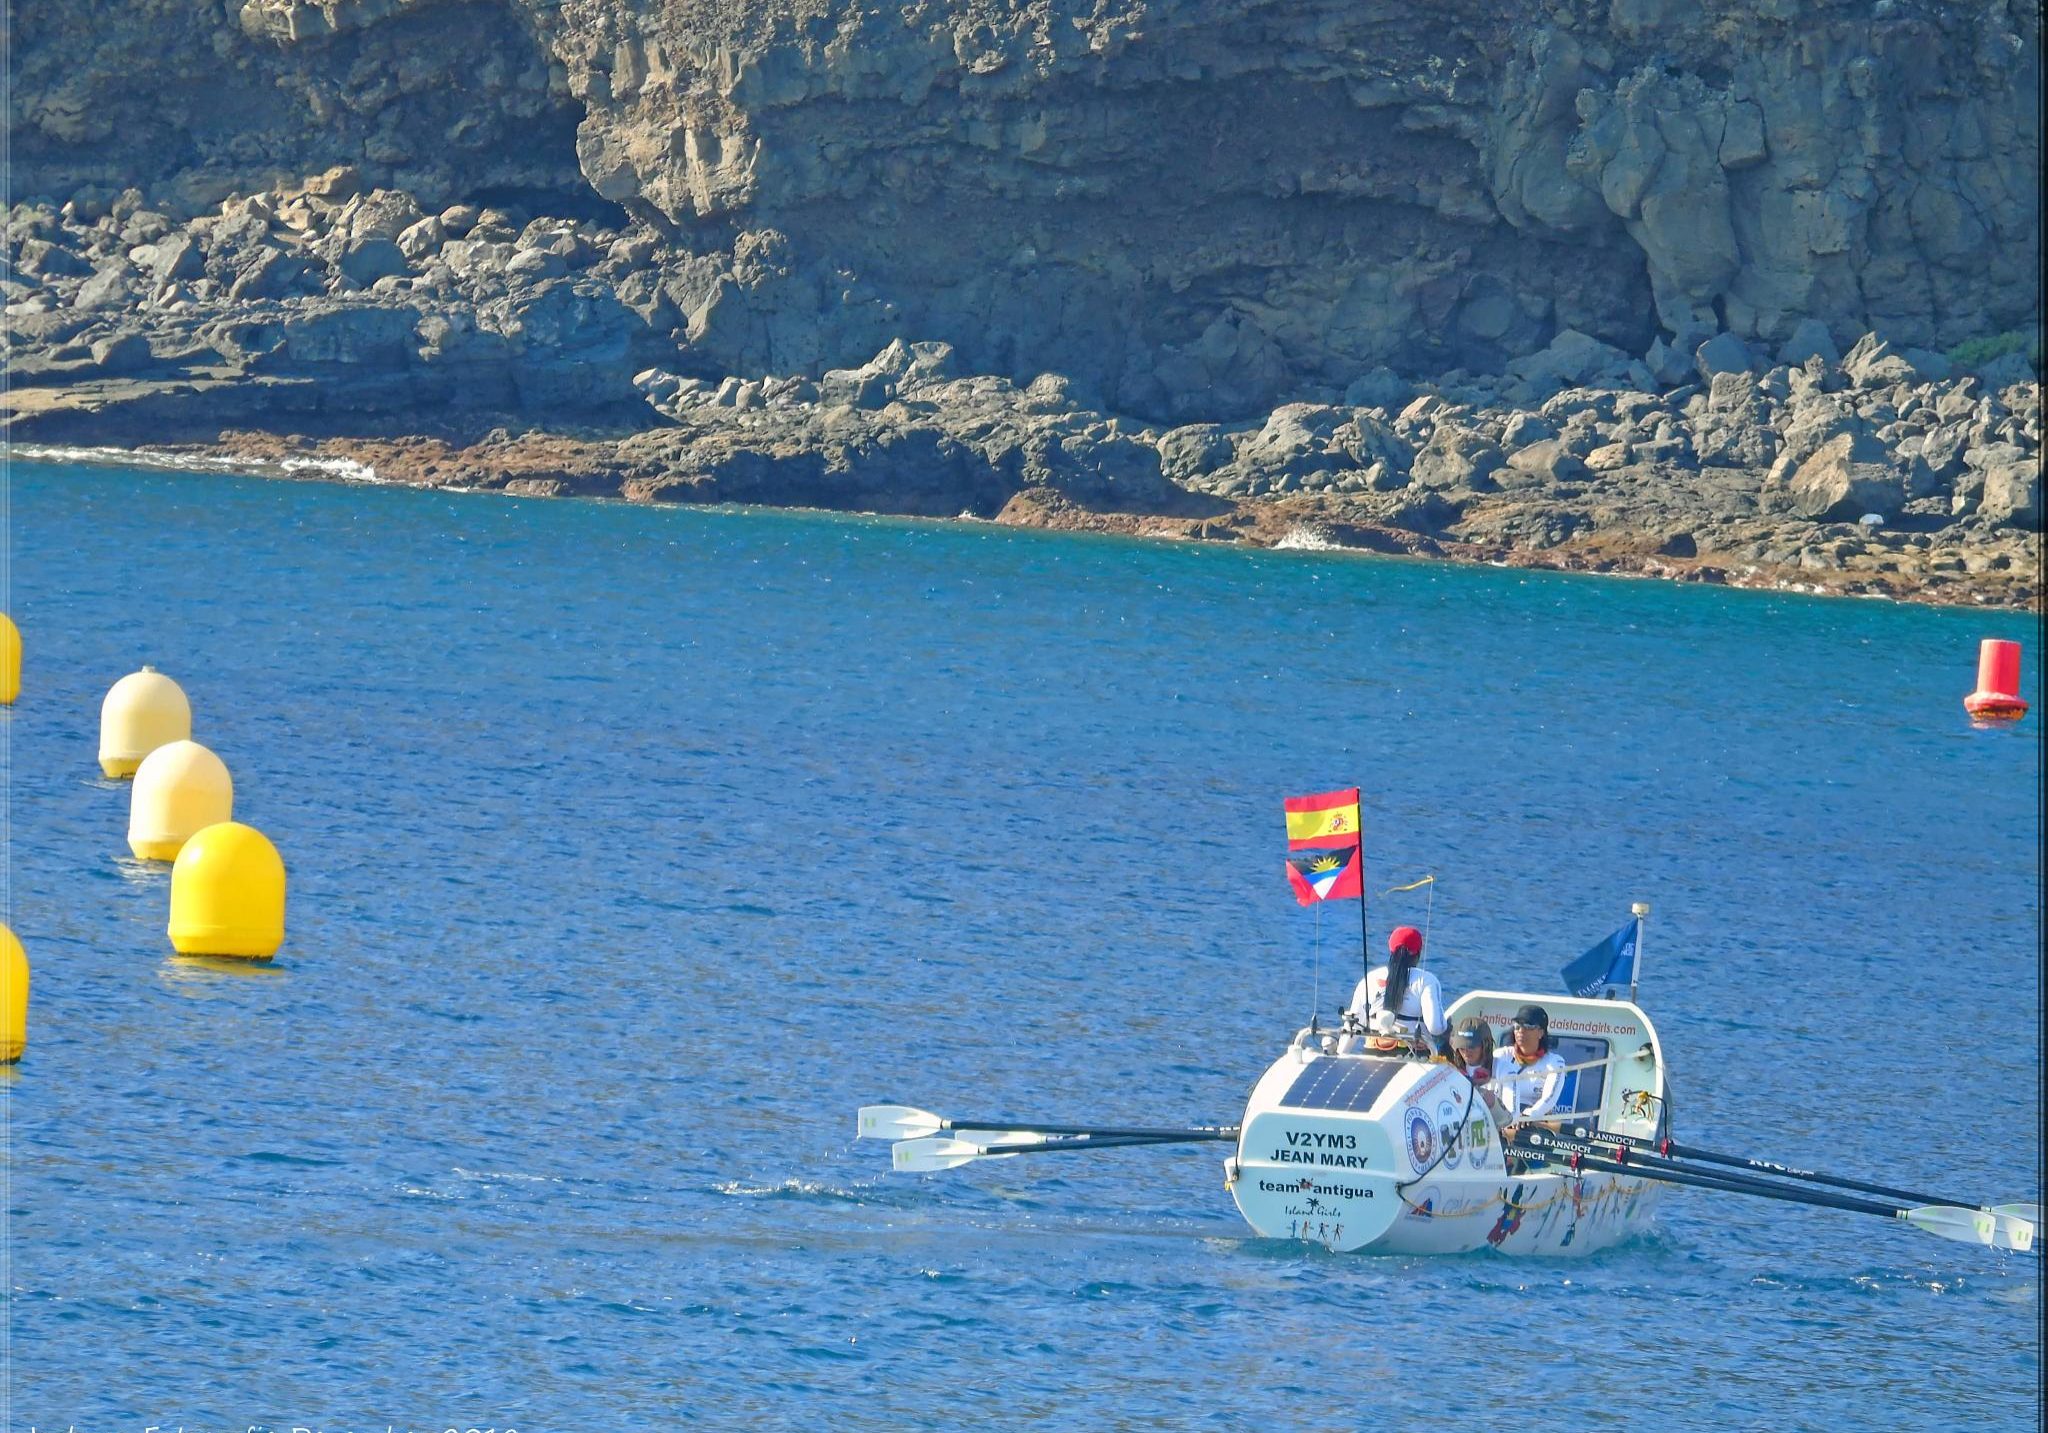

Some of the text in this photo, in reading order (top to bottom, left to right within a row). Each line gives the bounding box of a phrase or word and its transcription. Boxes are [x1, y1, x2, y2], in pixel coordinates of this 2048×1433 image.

[1286, 1131, 1357, 1150] V2YM3
[1543, 1138, 1591, 1154] RANNOCH
[1588, 1131, 1637, 1146] RANNOCH
[1270, 1149, 1368, 1169] JEAN MARY
[1503, 1149, 1545, 1161] ANNOCH
[1259, 1180, 1374, 1200] team antigua
[1284, 1205, 1341, 1218] Island Girls
